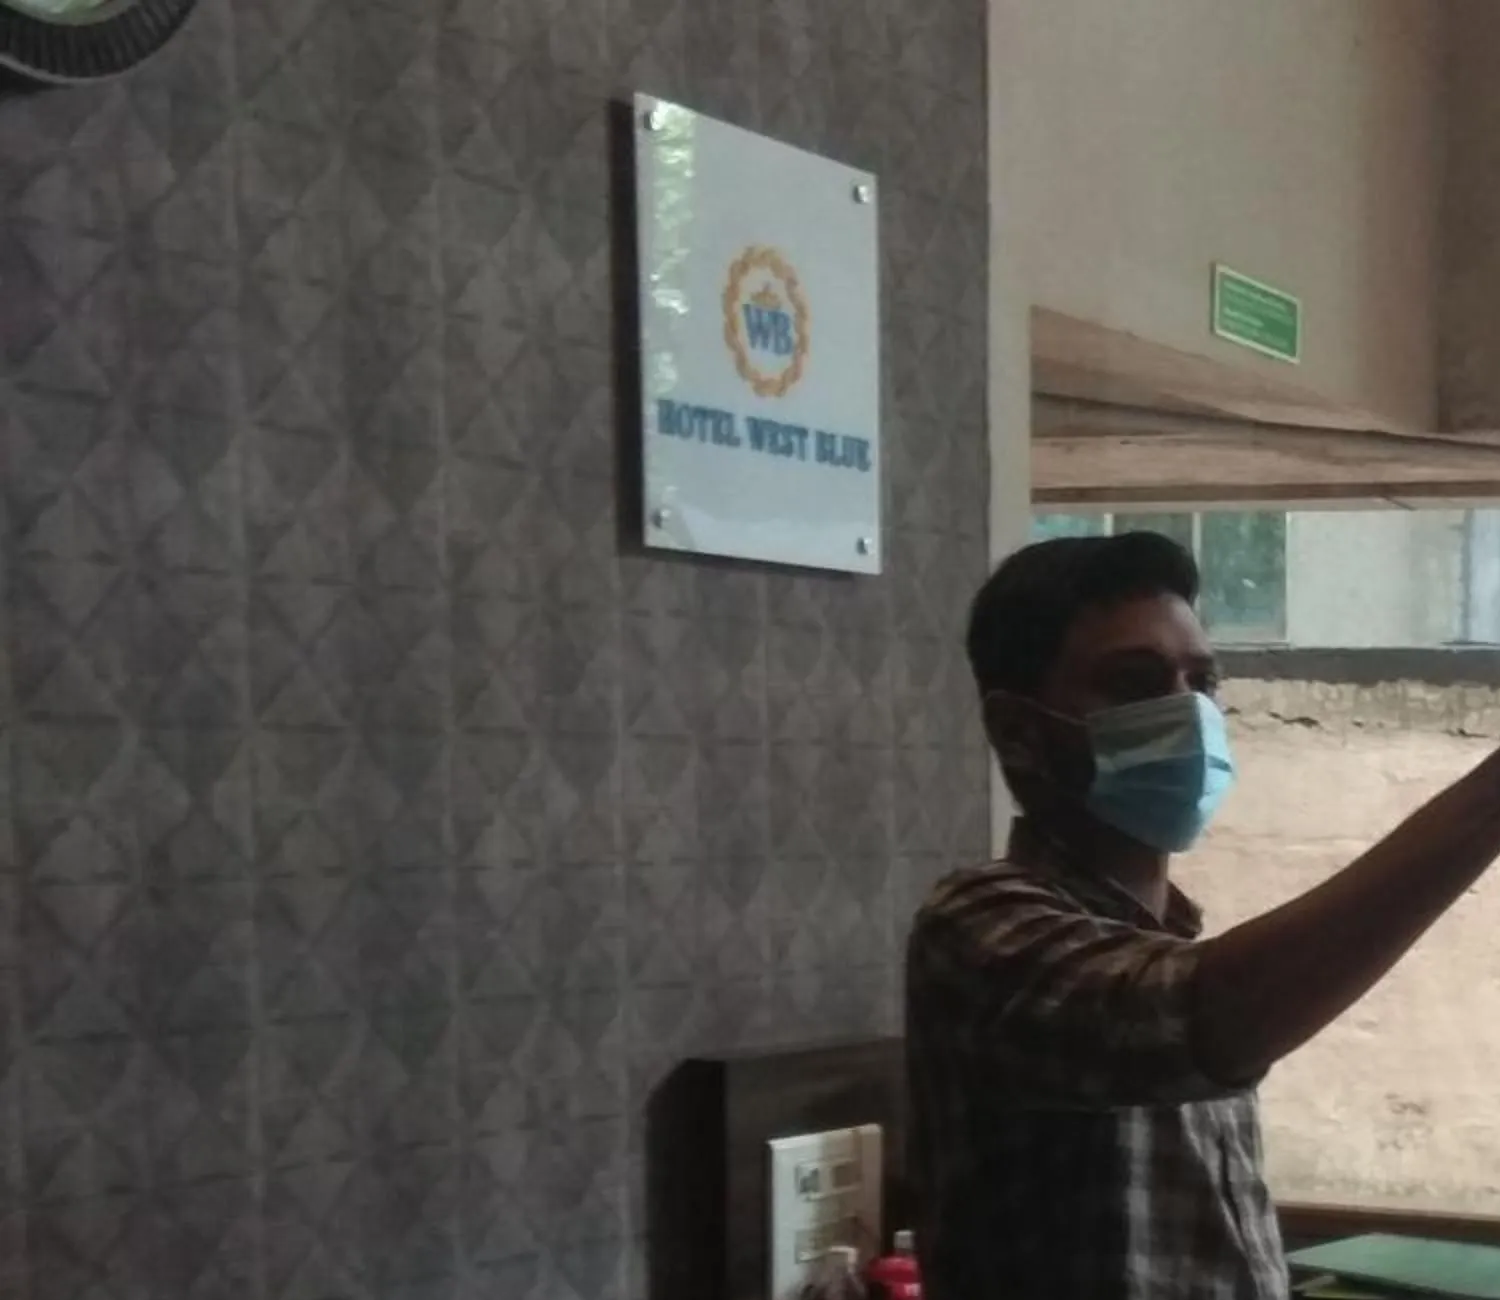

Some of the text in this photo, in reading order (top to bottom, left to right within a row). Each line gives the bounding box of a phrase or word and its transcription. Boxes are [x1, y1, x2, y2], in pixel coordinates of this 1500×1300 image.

[743, 303, 795, 355] WB
[657, 399, 871, 472] HOTEL WEST BLUE
